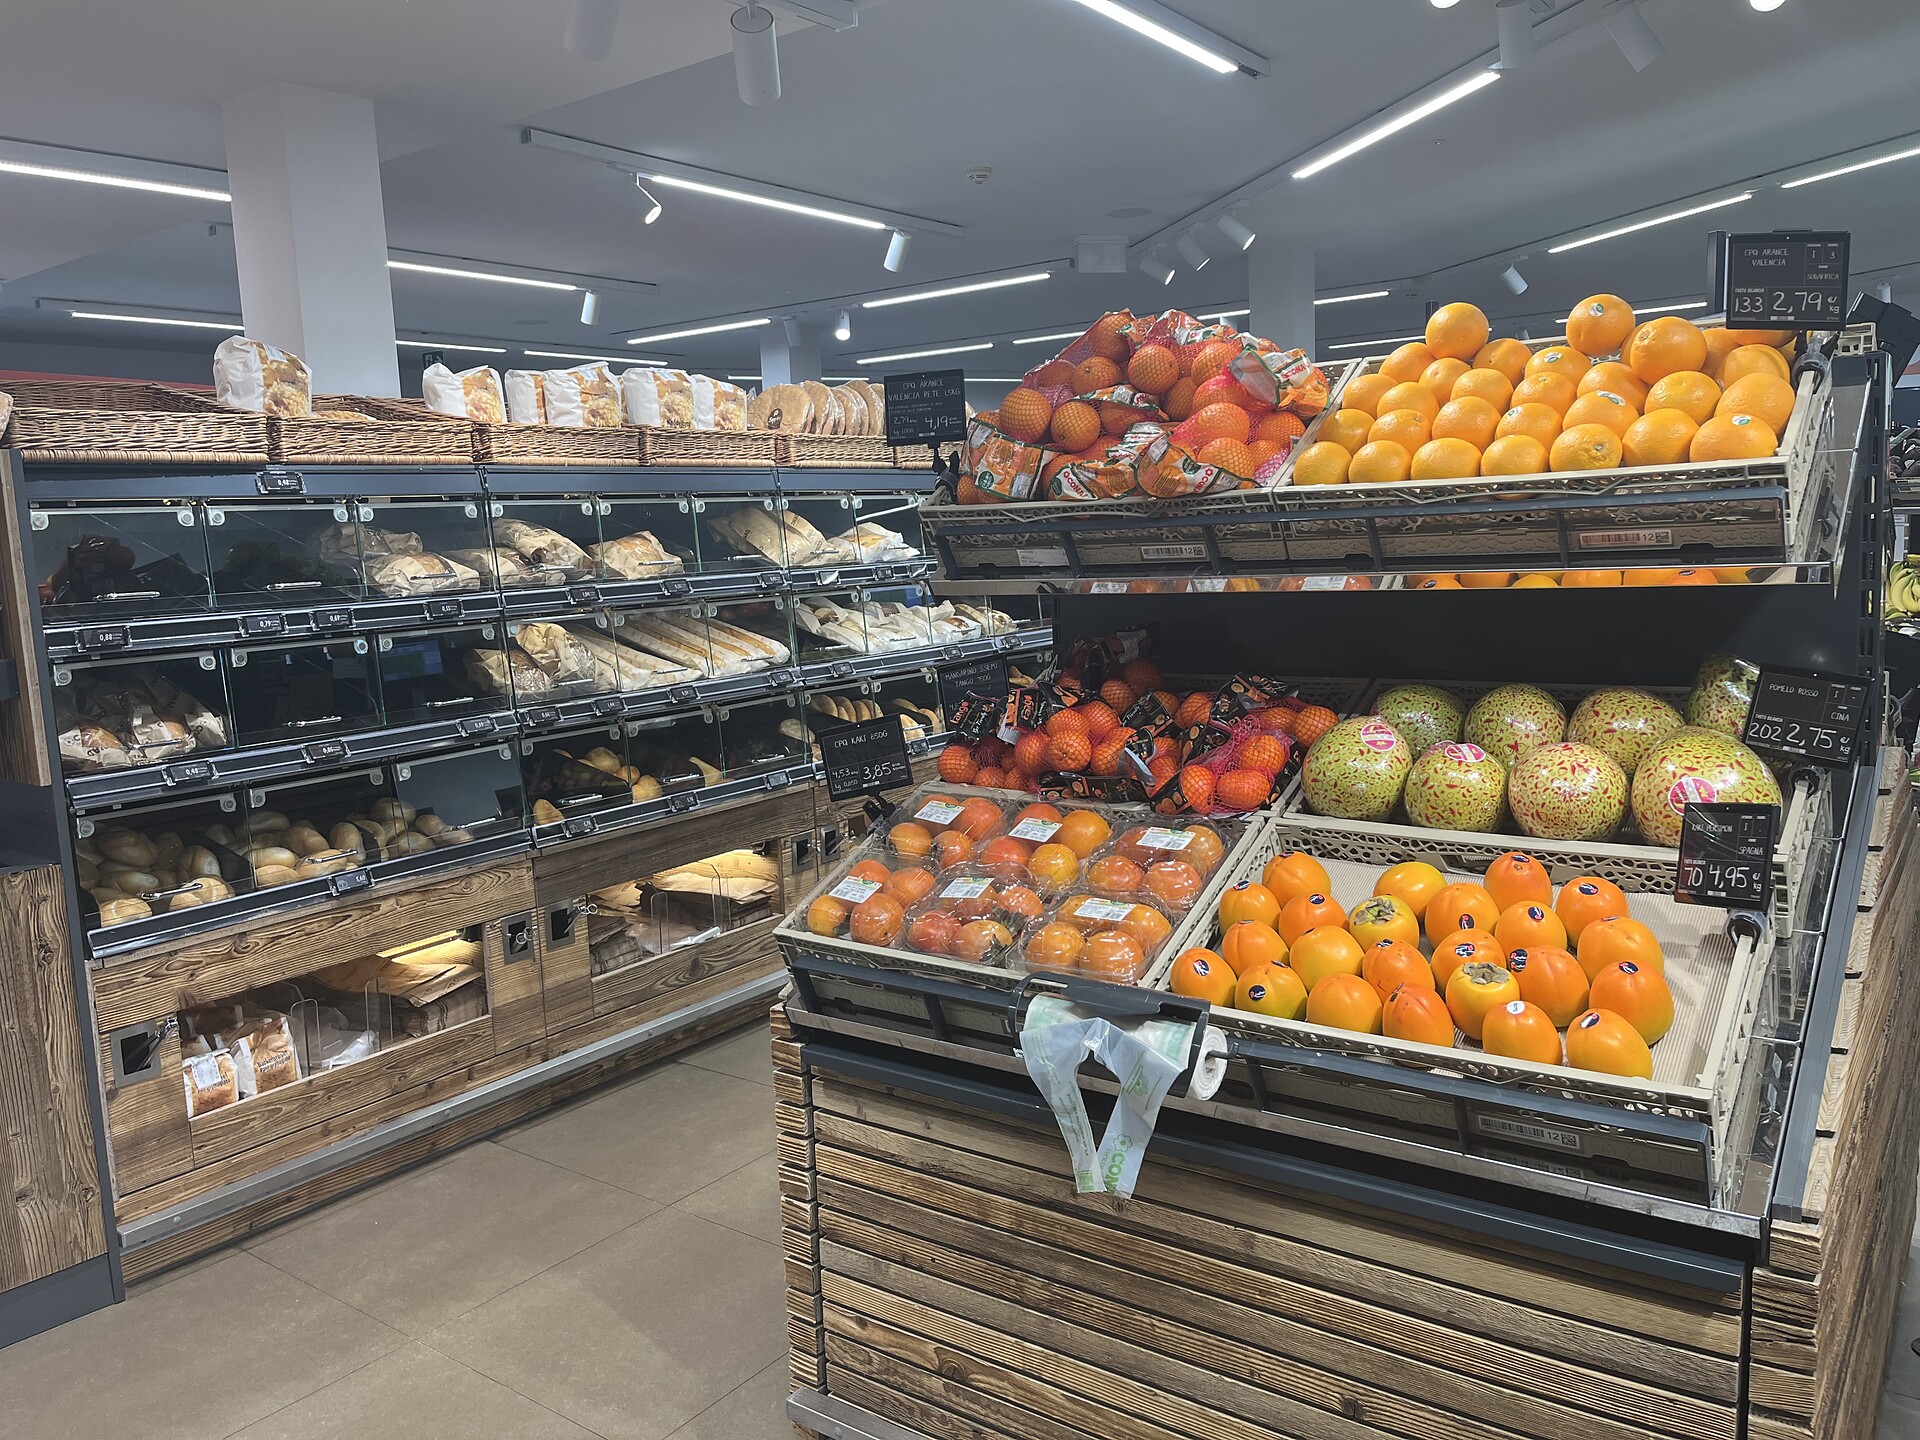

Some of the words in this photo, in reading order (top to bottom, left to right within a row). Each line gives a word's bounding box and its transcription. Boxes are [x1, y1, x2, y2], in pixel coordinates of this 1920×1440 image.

[1762, 248, 1789, 256] ARANCE
[1830, 251, 1835, 259] 3
[1751, 259, 1786, 267] VALENCIA
[1734, 296, 1764, 313] 133
[1772, 291, 1823, 314] 2,79
[1829, 305, 1840, 314] kg
[919, 379, 944, 388] ARANCE
[888, 391, 920, 401] VALENCIA
[923, 390, 940, 398] RETE
[893, 415, 910, 425] 2,79
[924, 415, 949, 430] 4,19
[1642, 533, 1655, 542] 12
[945, 667, 977, 680] MANDARINO
[955, 678, 974, 688] TANGO
[1769, 683, 1795, 694] POMELO
[1798, 688, 1819, 697] ROSSO
[949, 701, 969, 724] tango
[1830, 711, 1850, 722] CINA
[1749, 722, 1782, 742] 202
[1786, 723, 1837, 749] 2,75
[834, 739, 848, 748] CPQ
[851, 734, 867, 745] KAKI
[870, 730, 888, 740] 850G
[1840, 746, 1851, 755] kg
[832, 767, 851, 779] 4,53
[863, 761, 892, 780] 3,85
[1738, 846, 1763, 856] SPAGNA
[1684, 867, 1703, 887] 70
[1709, 864, 1750, 889] 4,95
[1753, 883, 1762, 892] kg
[1546, 1131, 1560, 1141] 12
